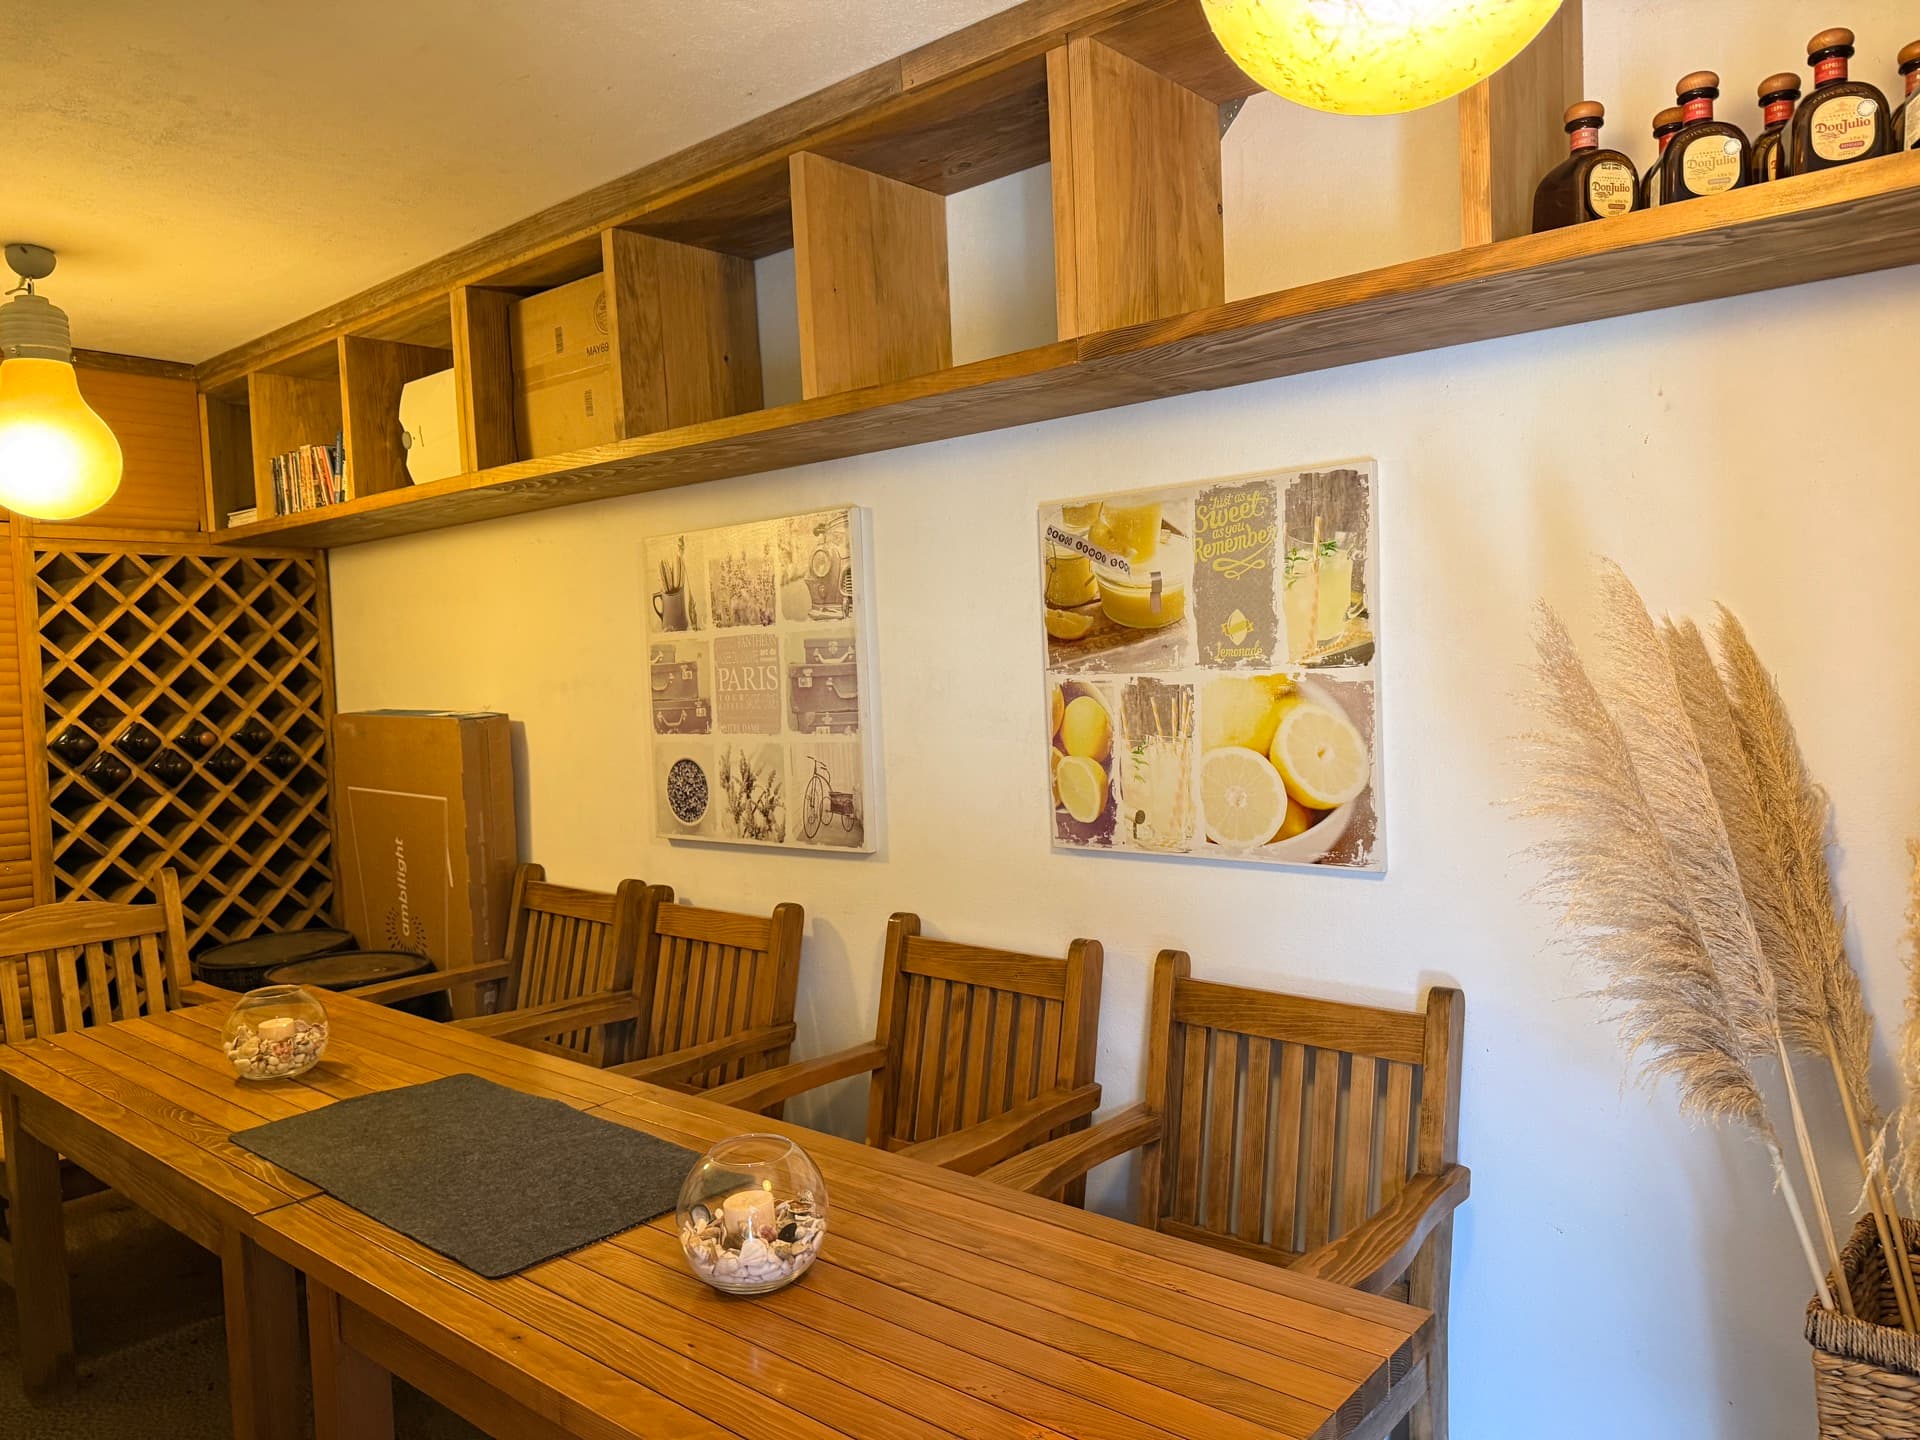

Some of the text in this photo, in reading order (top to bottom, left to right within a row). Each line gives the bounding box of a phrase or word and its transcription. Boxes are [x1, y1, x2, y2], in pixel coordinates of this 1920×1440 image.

[1194, 490, 1269, 534] Sweet
[1212, 521, 1246, 539] as you
[1194, 523, 1277, 564] Remember
[718, 665, 779, 692] PARIS
[395, 836, 410, 937] ambilight
